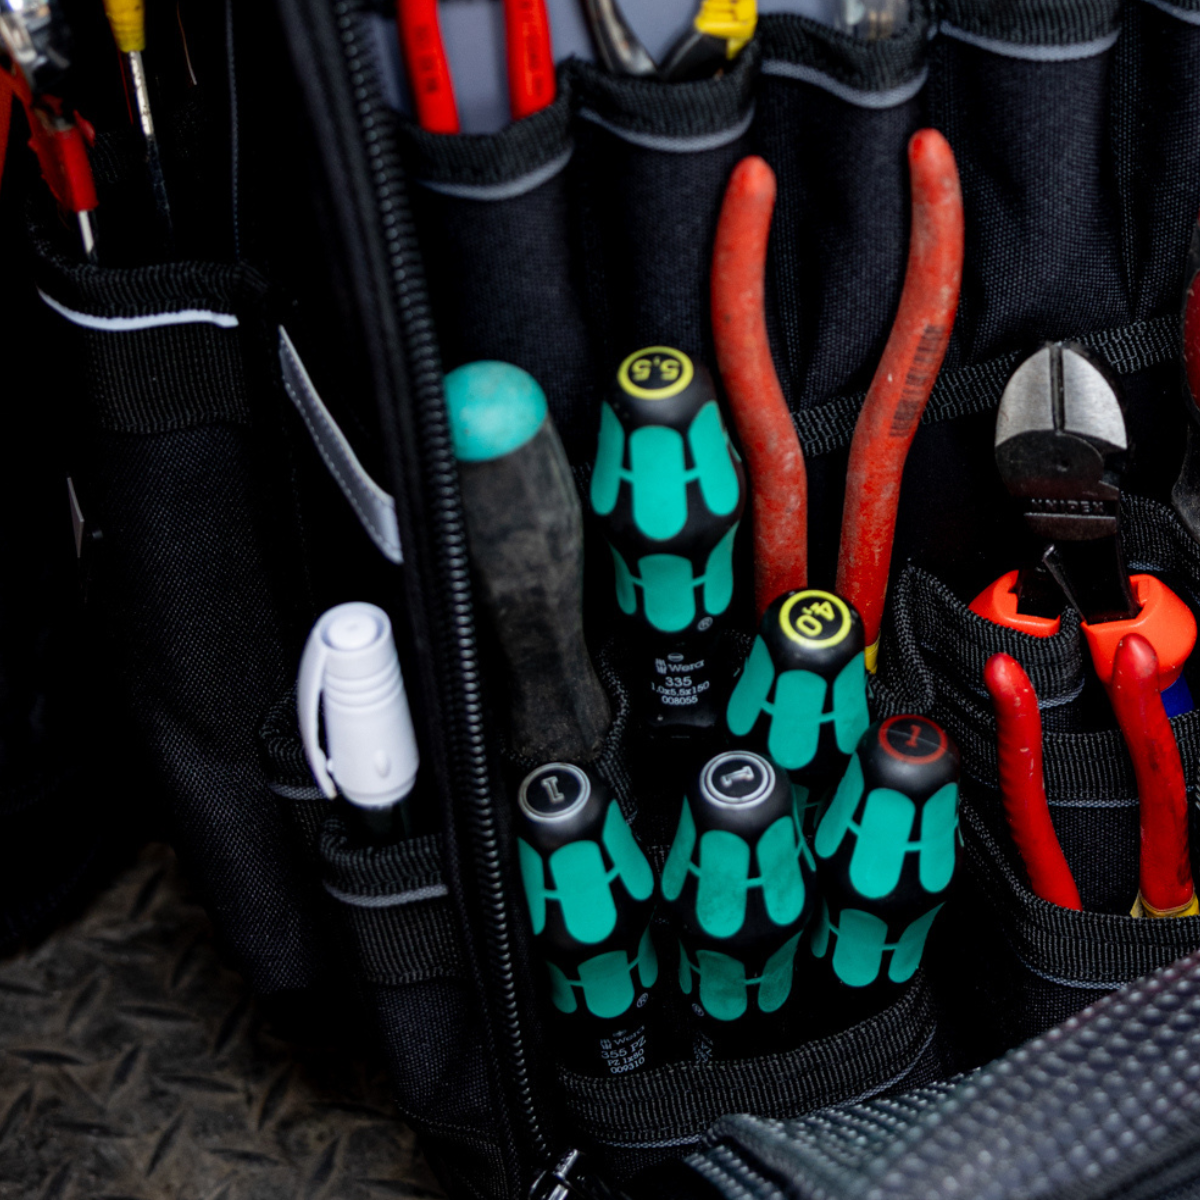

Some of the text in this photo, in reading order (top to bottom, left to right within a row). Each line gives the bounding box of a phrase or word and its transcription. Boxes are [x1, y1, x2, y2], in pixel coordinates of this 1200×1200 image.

[668, 659, 705, 673] Wera
[664, 675, 693, 688] 335
[661, 694, 699, 706] 008055
[905, 724, 922, 749] 1
[721, 765, 756, 788] 1
[541, 775, 566, 804] 1
[630, 1035, 647, 1053] PZ
[610, 1055, 646, 1075] 009310
